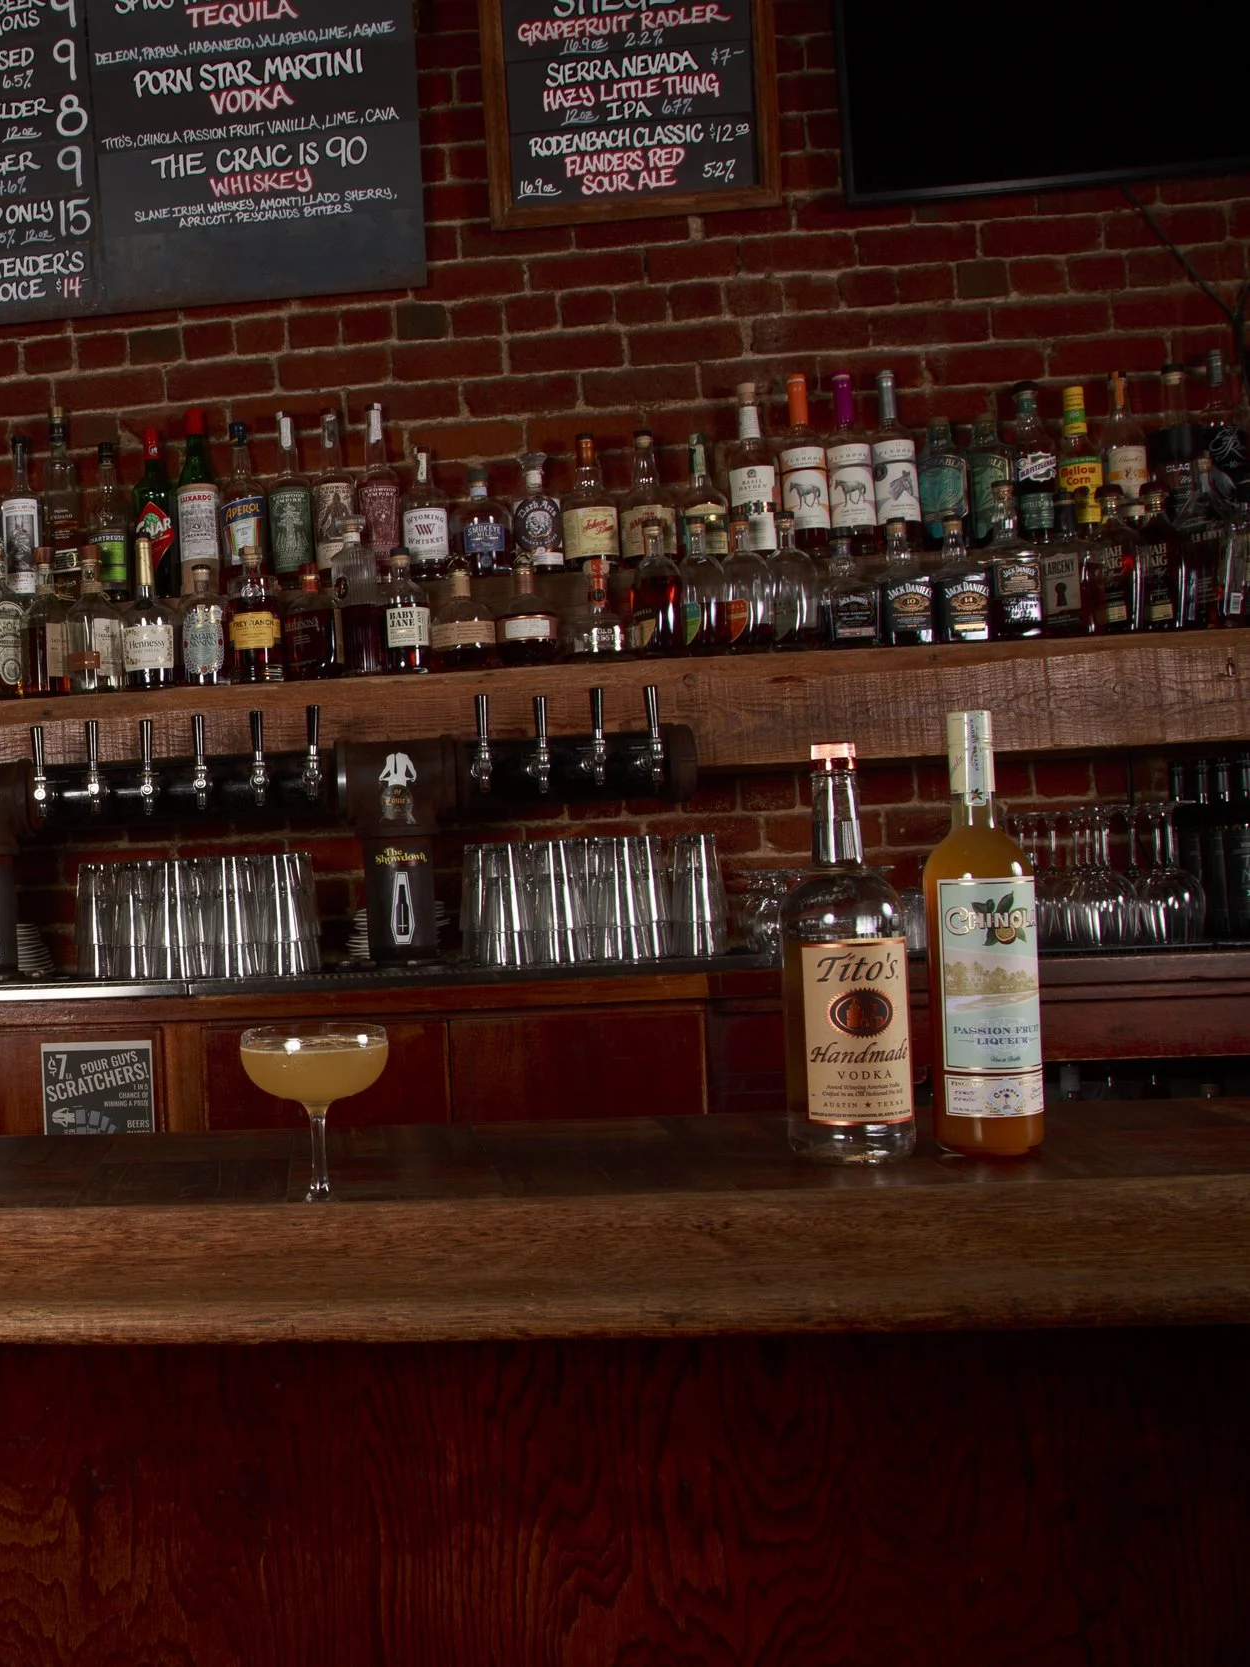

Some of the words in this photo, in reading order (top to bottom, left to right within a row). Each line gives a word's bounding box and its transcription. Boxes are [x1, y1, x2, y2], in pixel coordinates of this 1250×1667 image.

[185, 0, 300, 28] TEQUILA
[517, 12, 636, 47] GRAPEFRUIT
[640, 3, 732, 30] RADLER
[133, 65, 195, 99] PORN
[198, 57, 263, 91] STAR
[263, 47, 365, 85] MARTINI
[544, 58, 622, 88] SIERRA
[621, 49, 700, 78] NEVADA
[209, 84, 295, 116] VODKA
[542, 88, 596, 112] HAZY
[600, 78, 662, 102] LITTLE
[661, 72, 720, 98] THING
[606, 100, 655, 122] IPA
[183, 125, 227, 144] PASSION
[364, 106, 399, 122] CAVA
[528, 126, 632, 158] RODENBACH
[633, 122, 704, 148] CLASSIC
[150, 151, 207, 181] THE
[215, 142, 292, 175] CRAIC
[299, 140, 320, 166] IS
[324, 135, 369, 168] 90
[564, 150, 646, 178] FLANDERS
[648, 147, 686, 168] RED
[209, 167, 314, 198] WHISKEY
[581, 172, 635, 196] SOUR
[637, 168, 678, 188] ALE
[134, 207, 171, 224] SLANE
[1060, 465, 1096, 478] Mellow
[1066, 475, 1091, 485] Corn
[180, 493, 212, 504] LUXARDO
[225, 502, 260, 521] APEROL
[406, 514, 444, 524] WYOMING
[887, 585, 905, 599] JACK
[389, 611, 415, 620] BABY
[389, 619, 415, 628] JANE
[129, 640, 165, 651] Hennessy
[385, 847, 403, 857] The
[816, 952, 899, 983] Tito's
[953, 1026, 1012, 1035] PASSION
[976, 1036, 1029, 1045] LIQUEUR
[810, 1038, 908, 1064] Handmade
[80, 1058, 108, 1075] POUR
[110, 1051, 138, 1067] GUYS
[46, 1061, 149, 1102] SCRATCHERS!
[837, 1071, 892, 1080] VODKA
[877, 1099, 904, 1108] TEXAS
[127, 1120, 149, 1128] BEERS
